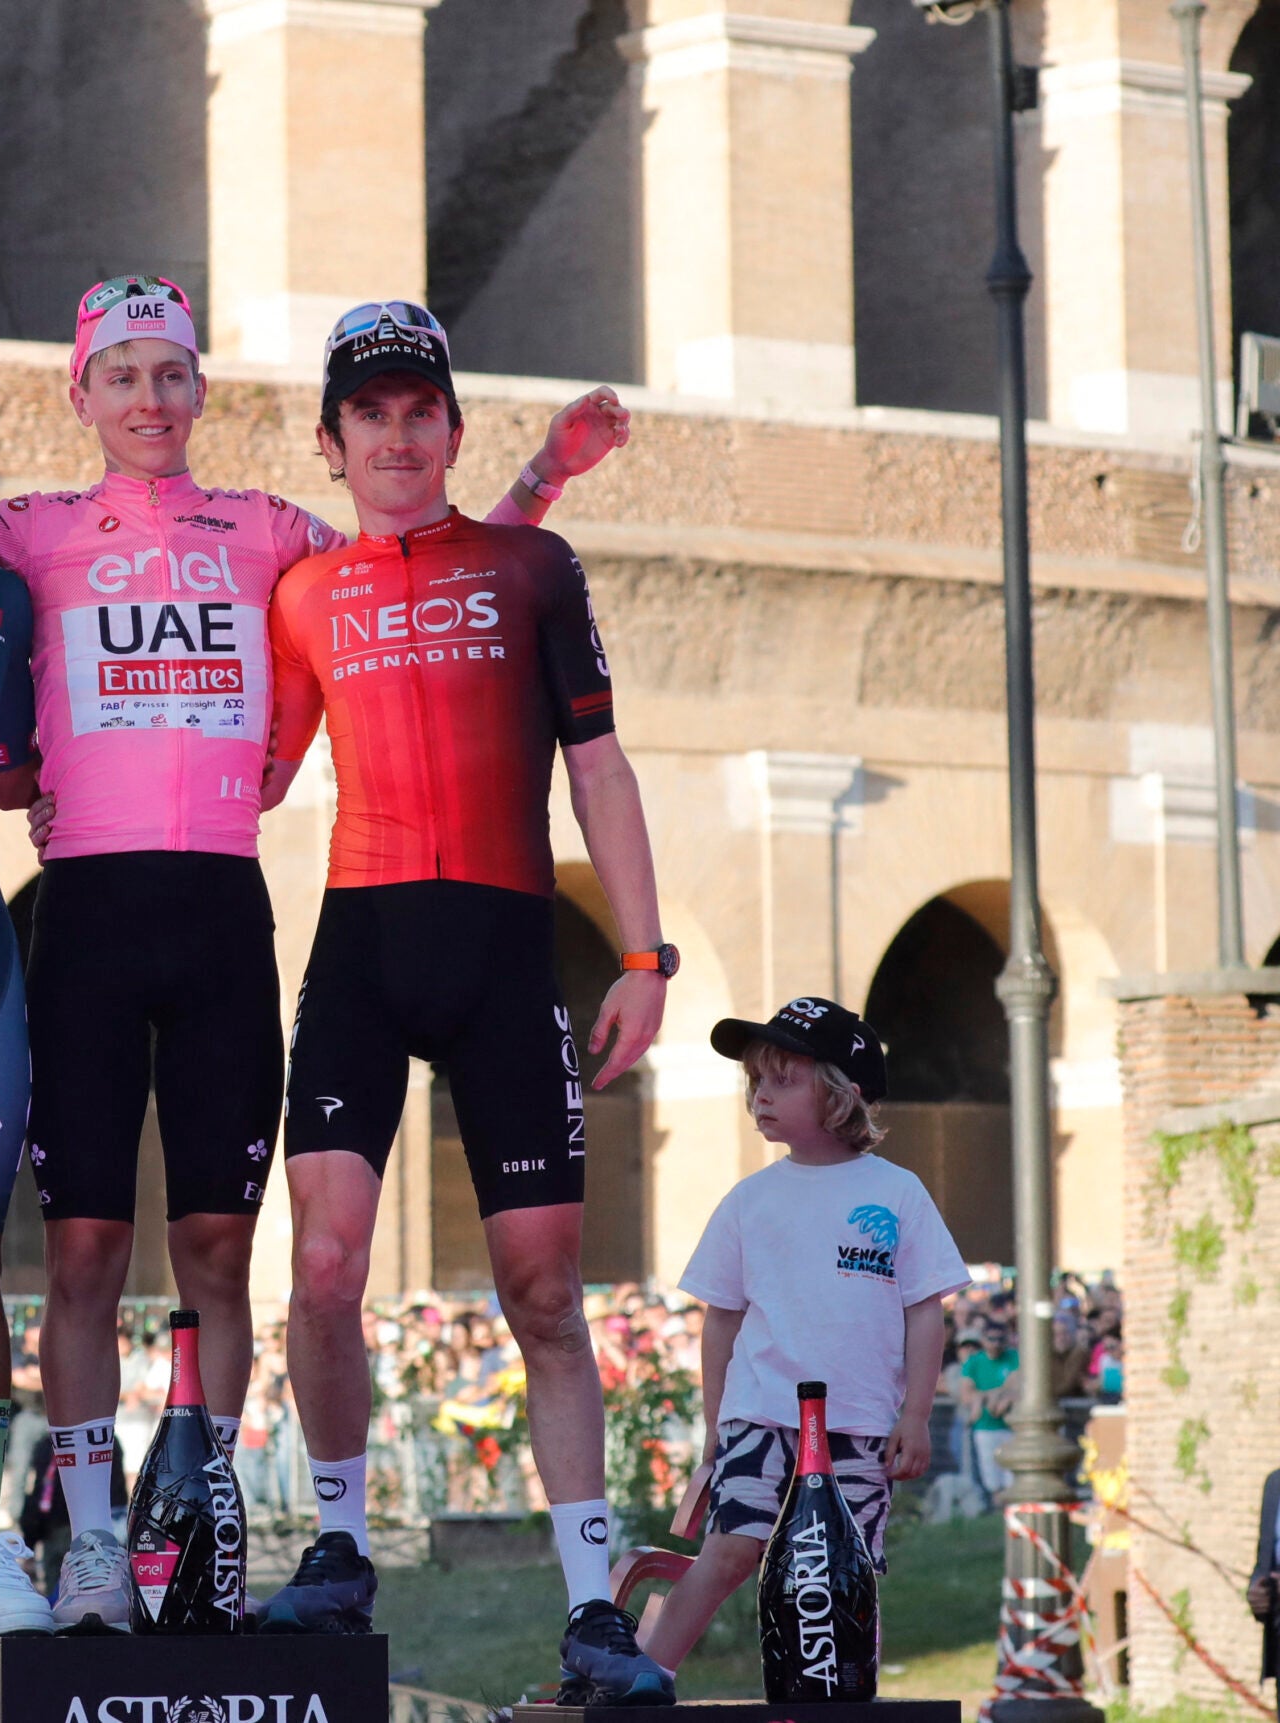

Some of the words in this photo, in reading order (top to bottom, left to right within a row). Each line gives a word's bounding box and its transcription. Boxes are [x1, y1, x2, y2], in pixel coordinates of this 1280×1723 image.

[127, 303, 165, 319] UAE
[128, 321, 165, 330] Emirates
[354, 345, 436, 363] GRENADIER
[414, 523, 451, 538] GRENADIER
[87, 545, 240, 594] enel
[429, 571, 497, 586] PINARELLO
[331, 584, 374, 600] GOBIK
[98, 603, 236, 655] UAE
[329, 591, 499, 652] INEOS
[103, 663, 240, 691] Emirates
[333, 646, 506, 681] GRENADIER
[553, 1004, 586, 1160] INEOS
[502, 1158, 547, 1174] GOBIK
[837, 1258, 855, 1270] LOS
[857, 1261, 897, 1279] ANGELE
[173, 1343, 181, 1386] ASTORIA
[808, 1412, 817, 1455] ASTORIA
[202, 1442, 241, 1631] ASTORIA
[138, 1562, 163, 1576] enel
[792, 1510, 839, 1697] ASTORIA
